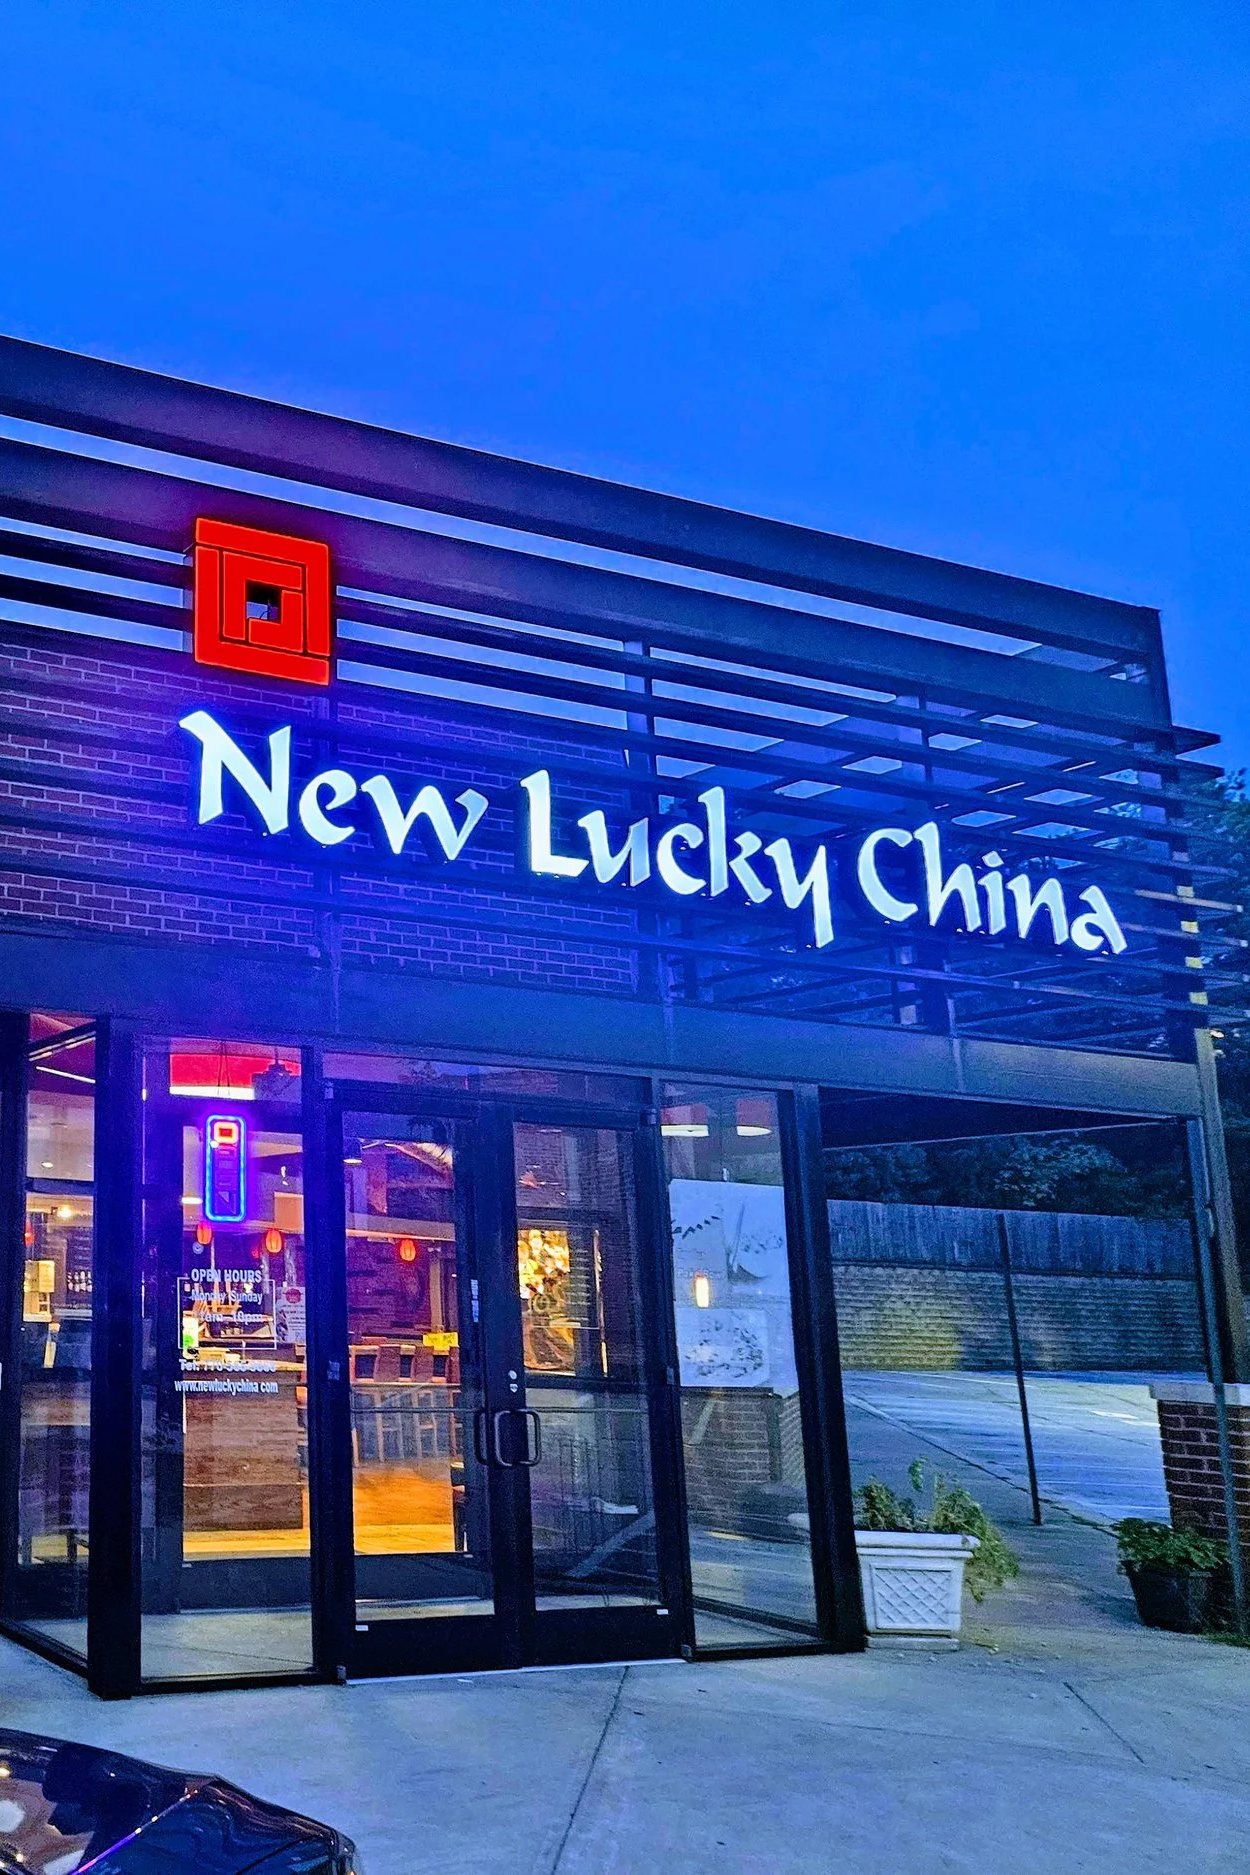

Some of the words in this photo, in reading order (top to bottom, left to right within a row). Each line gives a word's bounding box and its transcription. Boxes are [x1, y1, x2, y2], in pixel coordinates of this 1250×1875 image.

[179, 710, 489, 861] New
[520, 769, 835, 948] Lucky
[857, 821, 1128, 955] China
[191, 1268, 221, 1283] OPEN
[224, 1269, 262, 1283] HOURS
[231, 1289, 263, 1305] Sunday
[174, 1378, 279, 1396] www.newluckychinacom
